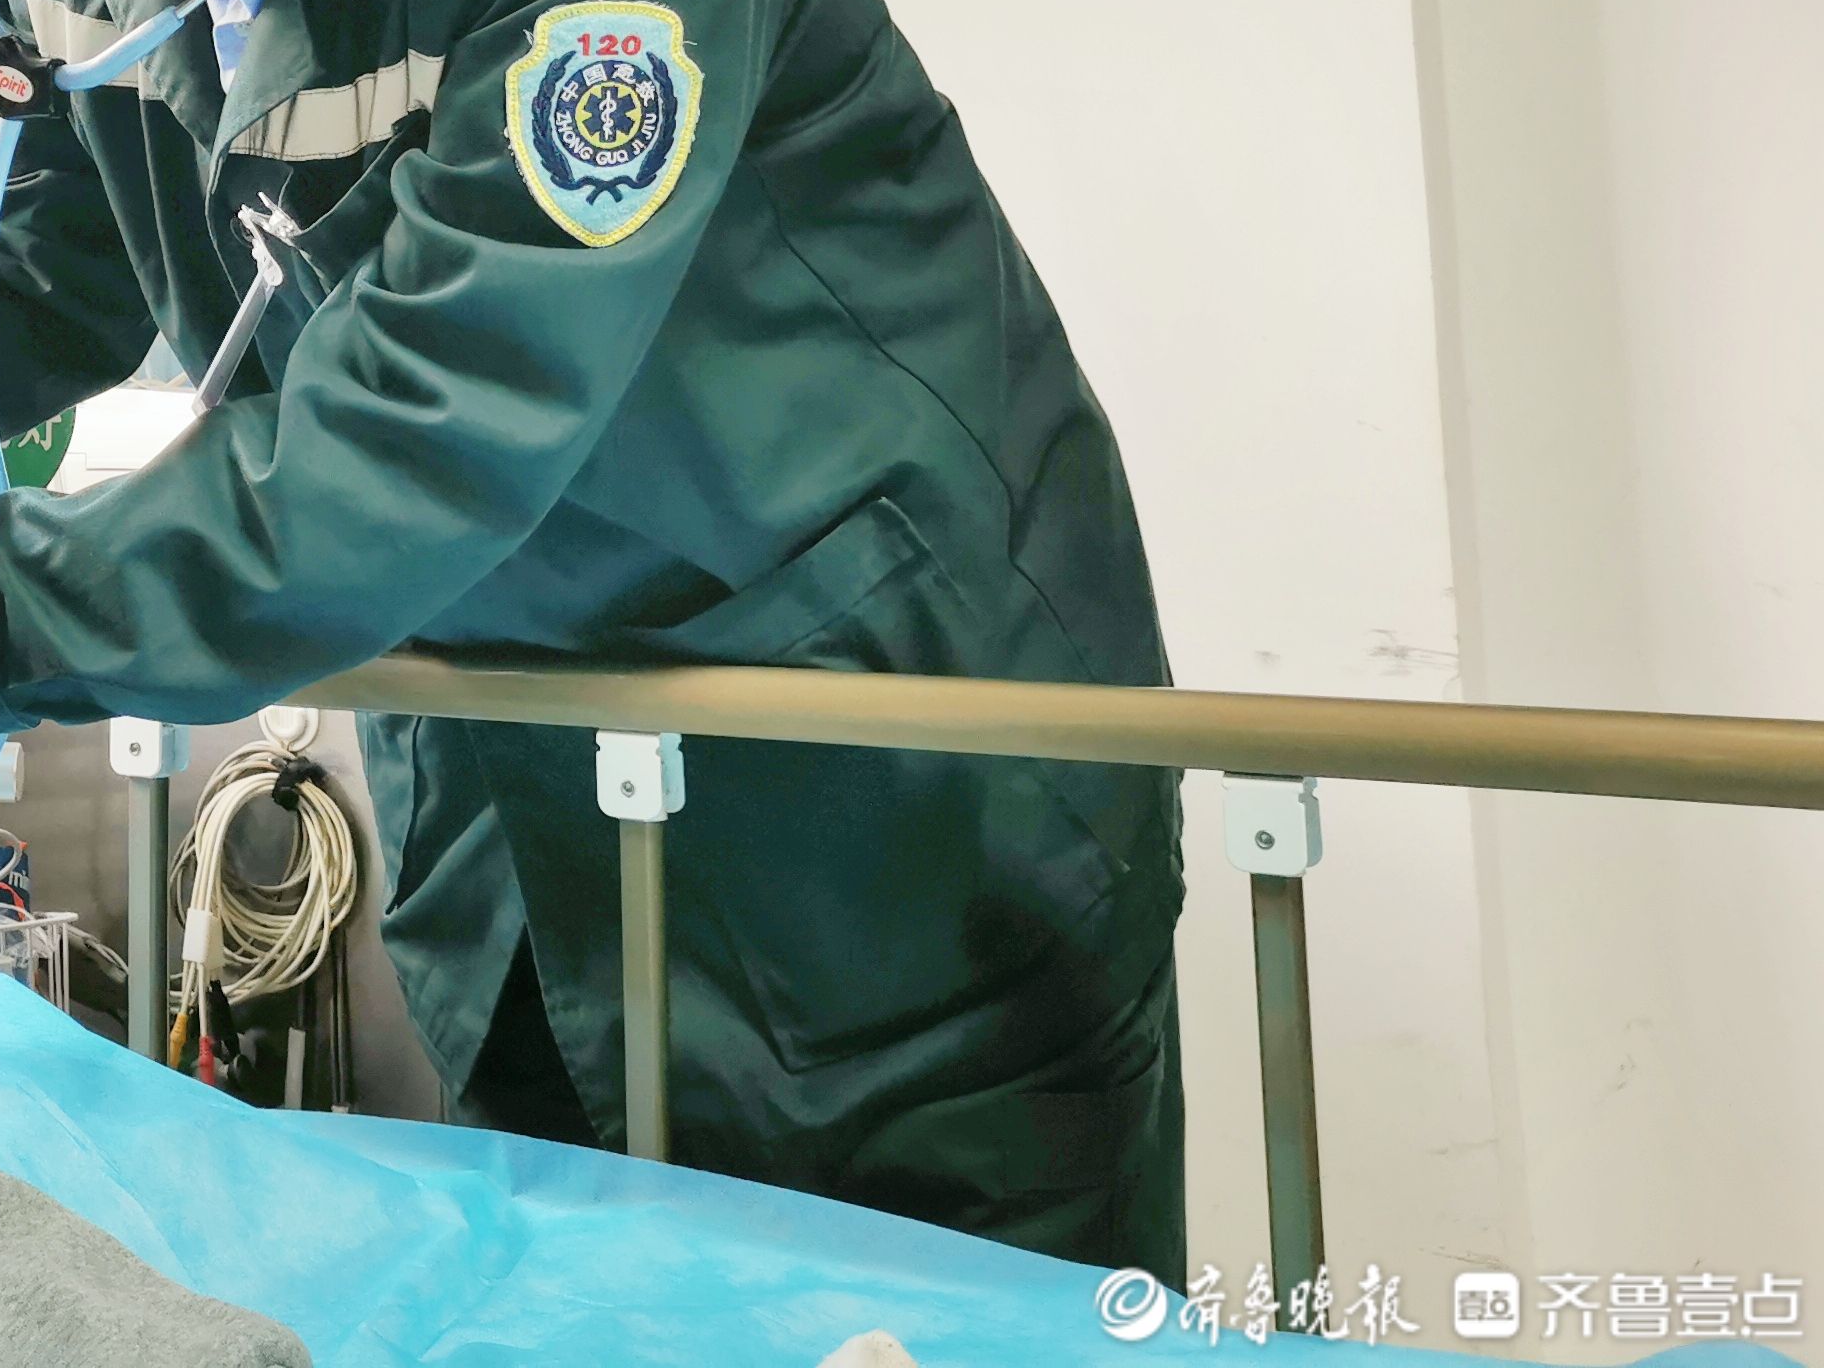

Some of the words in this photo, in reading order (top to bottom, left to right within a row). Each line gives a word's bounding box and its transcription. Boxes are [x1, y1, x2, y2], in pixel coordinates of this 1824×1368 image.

[577, 33, 642, 57] 120
[555, 110, 594, 160] ZHONG
[595, 150, 629, 166] GUO
